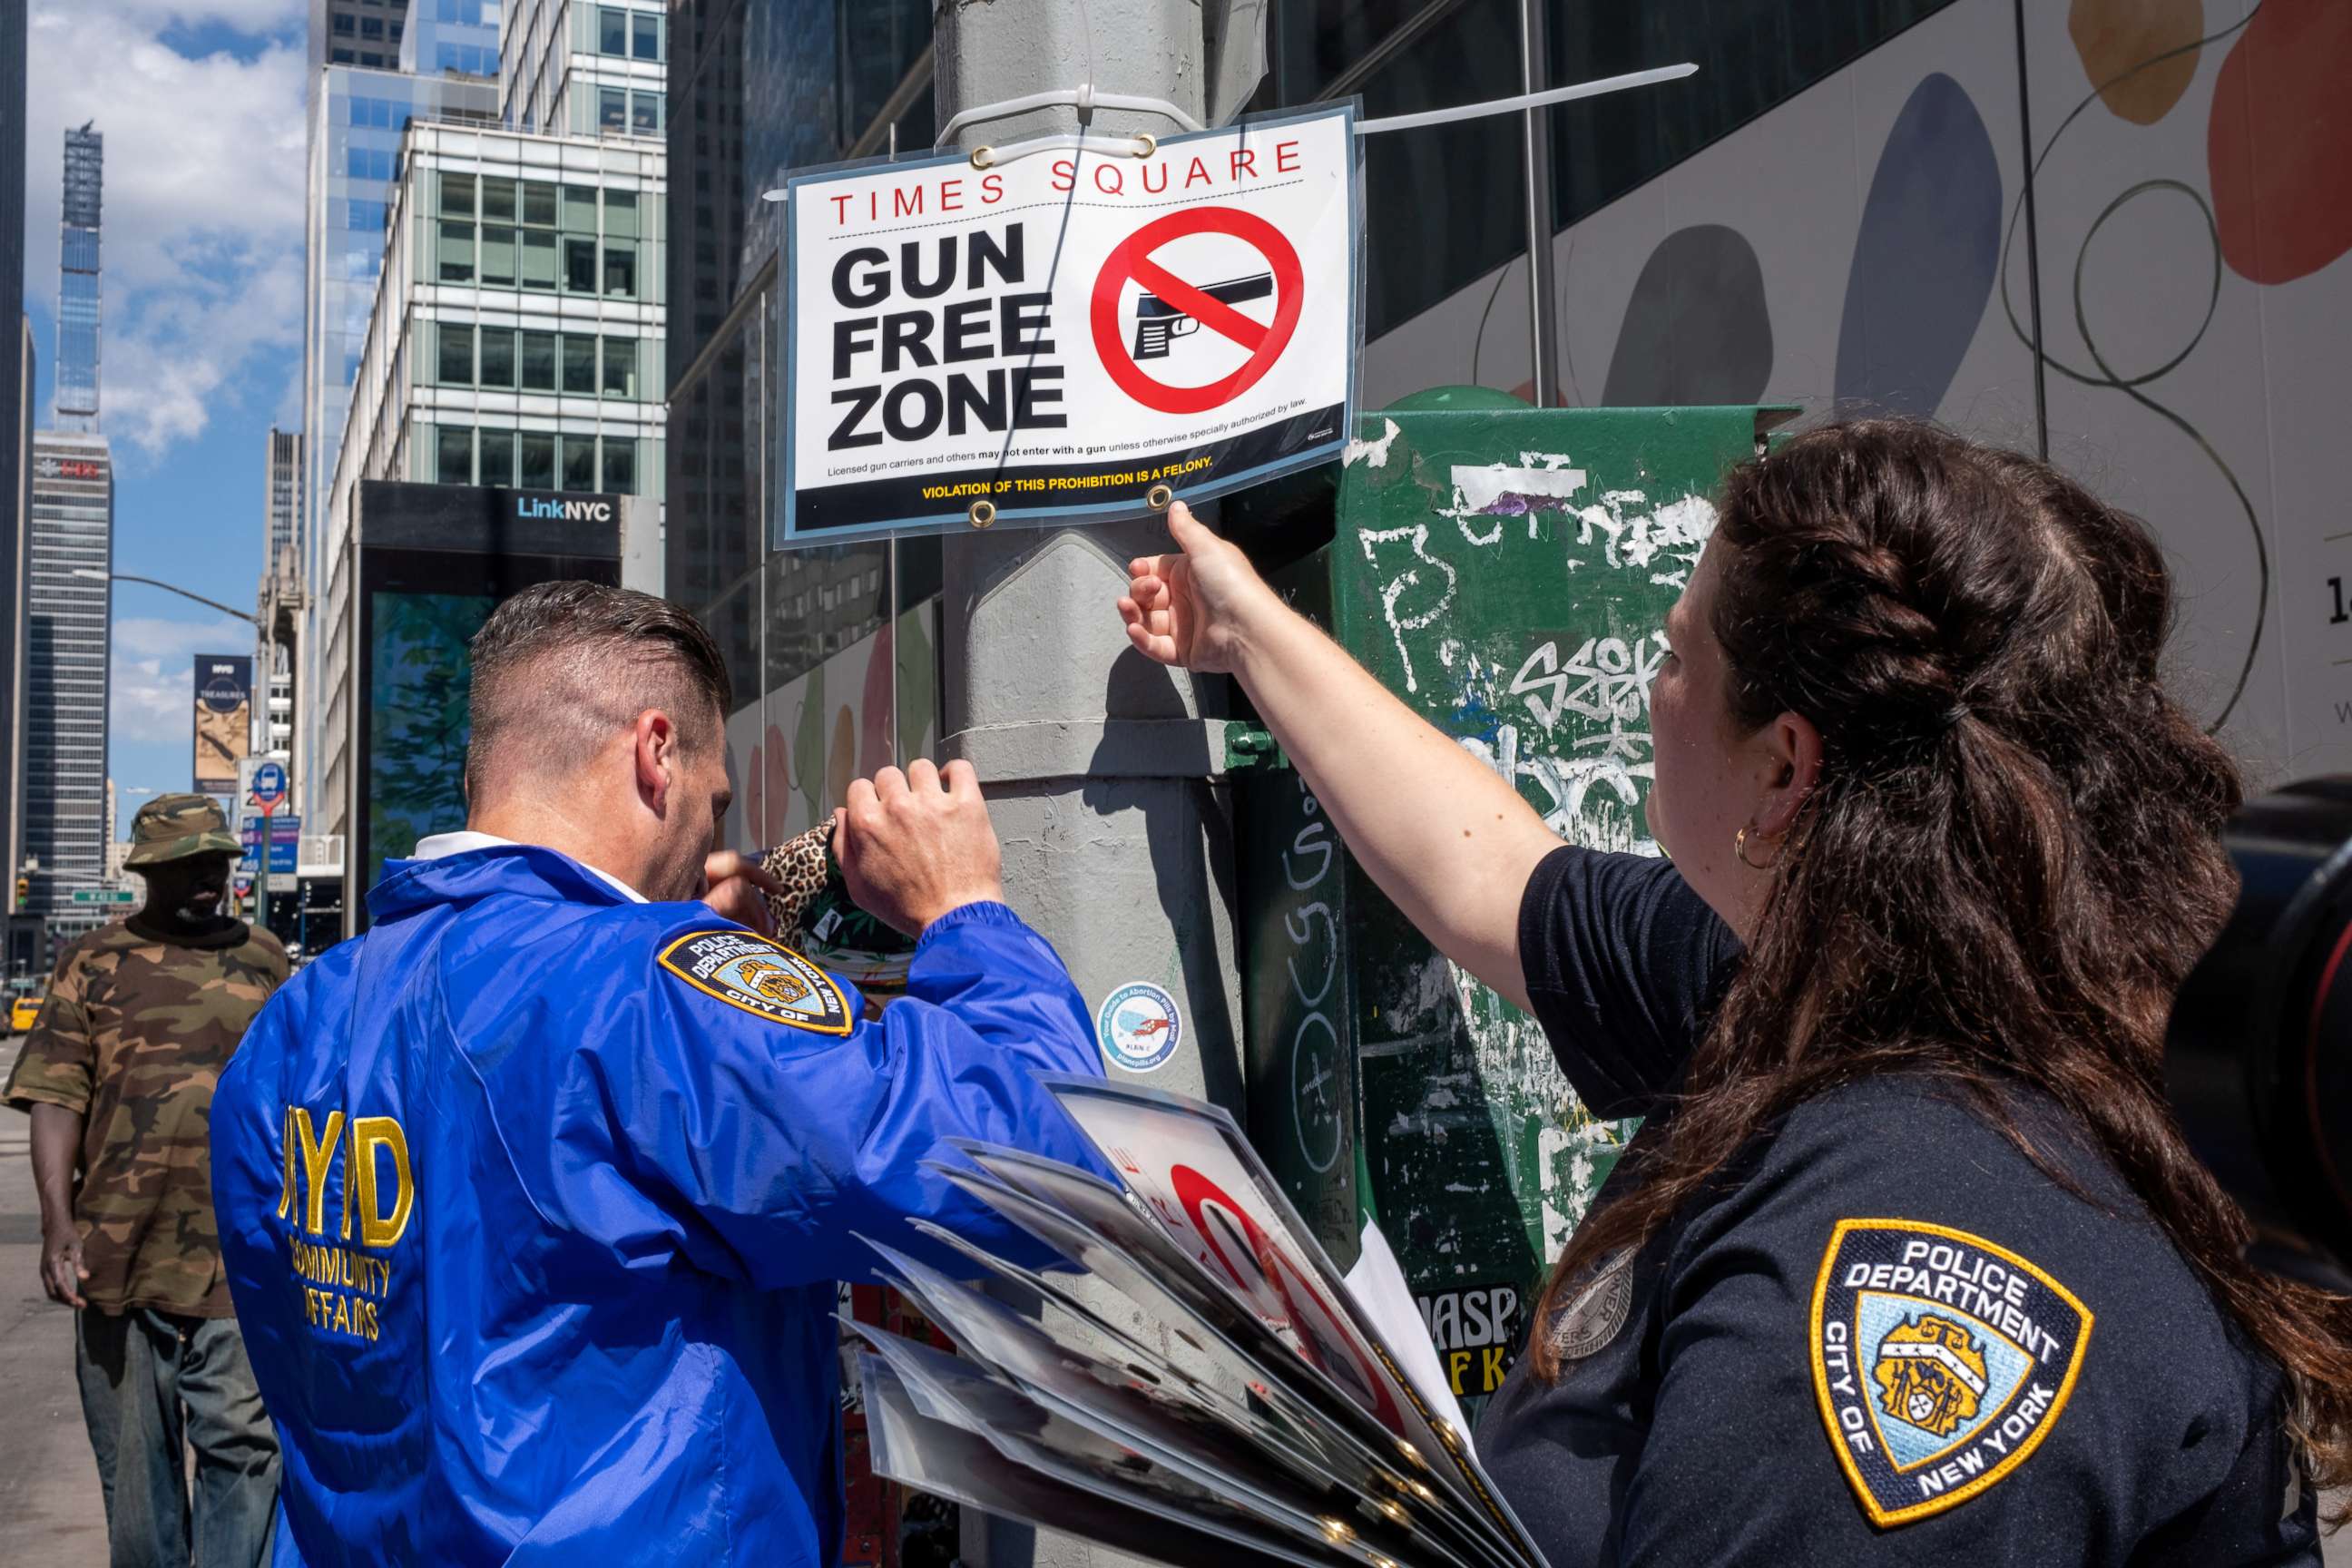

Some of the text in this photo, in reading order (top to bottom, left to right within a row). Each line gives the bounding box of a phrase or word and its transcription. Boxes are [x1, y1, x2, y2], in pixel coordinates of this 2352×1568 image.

[829, 141, 1301, 225] TIMES SQUARE
[831, 222, 1024, 309] GUN
[832, 292, 1055, 380] FREE
[828, 366, 1067, 451] ZONE
[828, 463, 867, 476] Licensed
[870, 463, 887, 474] gun
[889, 458, 924, 469] carriers
[926, 455, 944, 465] and
[946, 452, 975, 463] others
[978, 450, 1000, 460] may
[1004, 447, 1020, 457] not
[1023, 447, 1050, 456] enter
[1052, 445, 1074, 455] with
[1086, 445, 1106, 456] gun
[1109, 439, 1141, 452] unless
[1142, 432, 1188, 448] otherwise
[1190, 420, 1229, 440] specially
[1230, 407, 1276, 429] authorized
[1278, 405, 1289, 414] by
[1290, 398, 1308, 409] law.
[517, 497, 611, 522] LinkNYC
[922, 456, 1213, 499] VIOLATION OF THIS PROHIBITION IS A FELONY.
[199, 690, 246, 700] TREASURES
[688, 935, 745, 957] POLICE
[691, 943, 779, 980] DEPARTMENT
[725, 989, 809, 1022] CITY OF
[789, 956, 841, 1014] NEW YORK
[1129, 987, 1161, 1002] Abortion
[276, 1103, 415, 1247] YD
[289, 1234, 390, 1298] OMMUNITY
[1902, 1240, 2029, 1307] POLICE
[303, 1285, 379, 1341] FFAIRS
[1844, 1262, 2060, 1365] DEPARTMENT
[1825, 1319, 1876, 1455] CITY OF
[1916, 1381, 2054, 1497] NEW YORK
